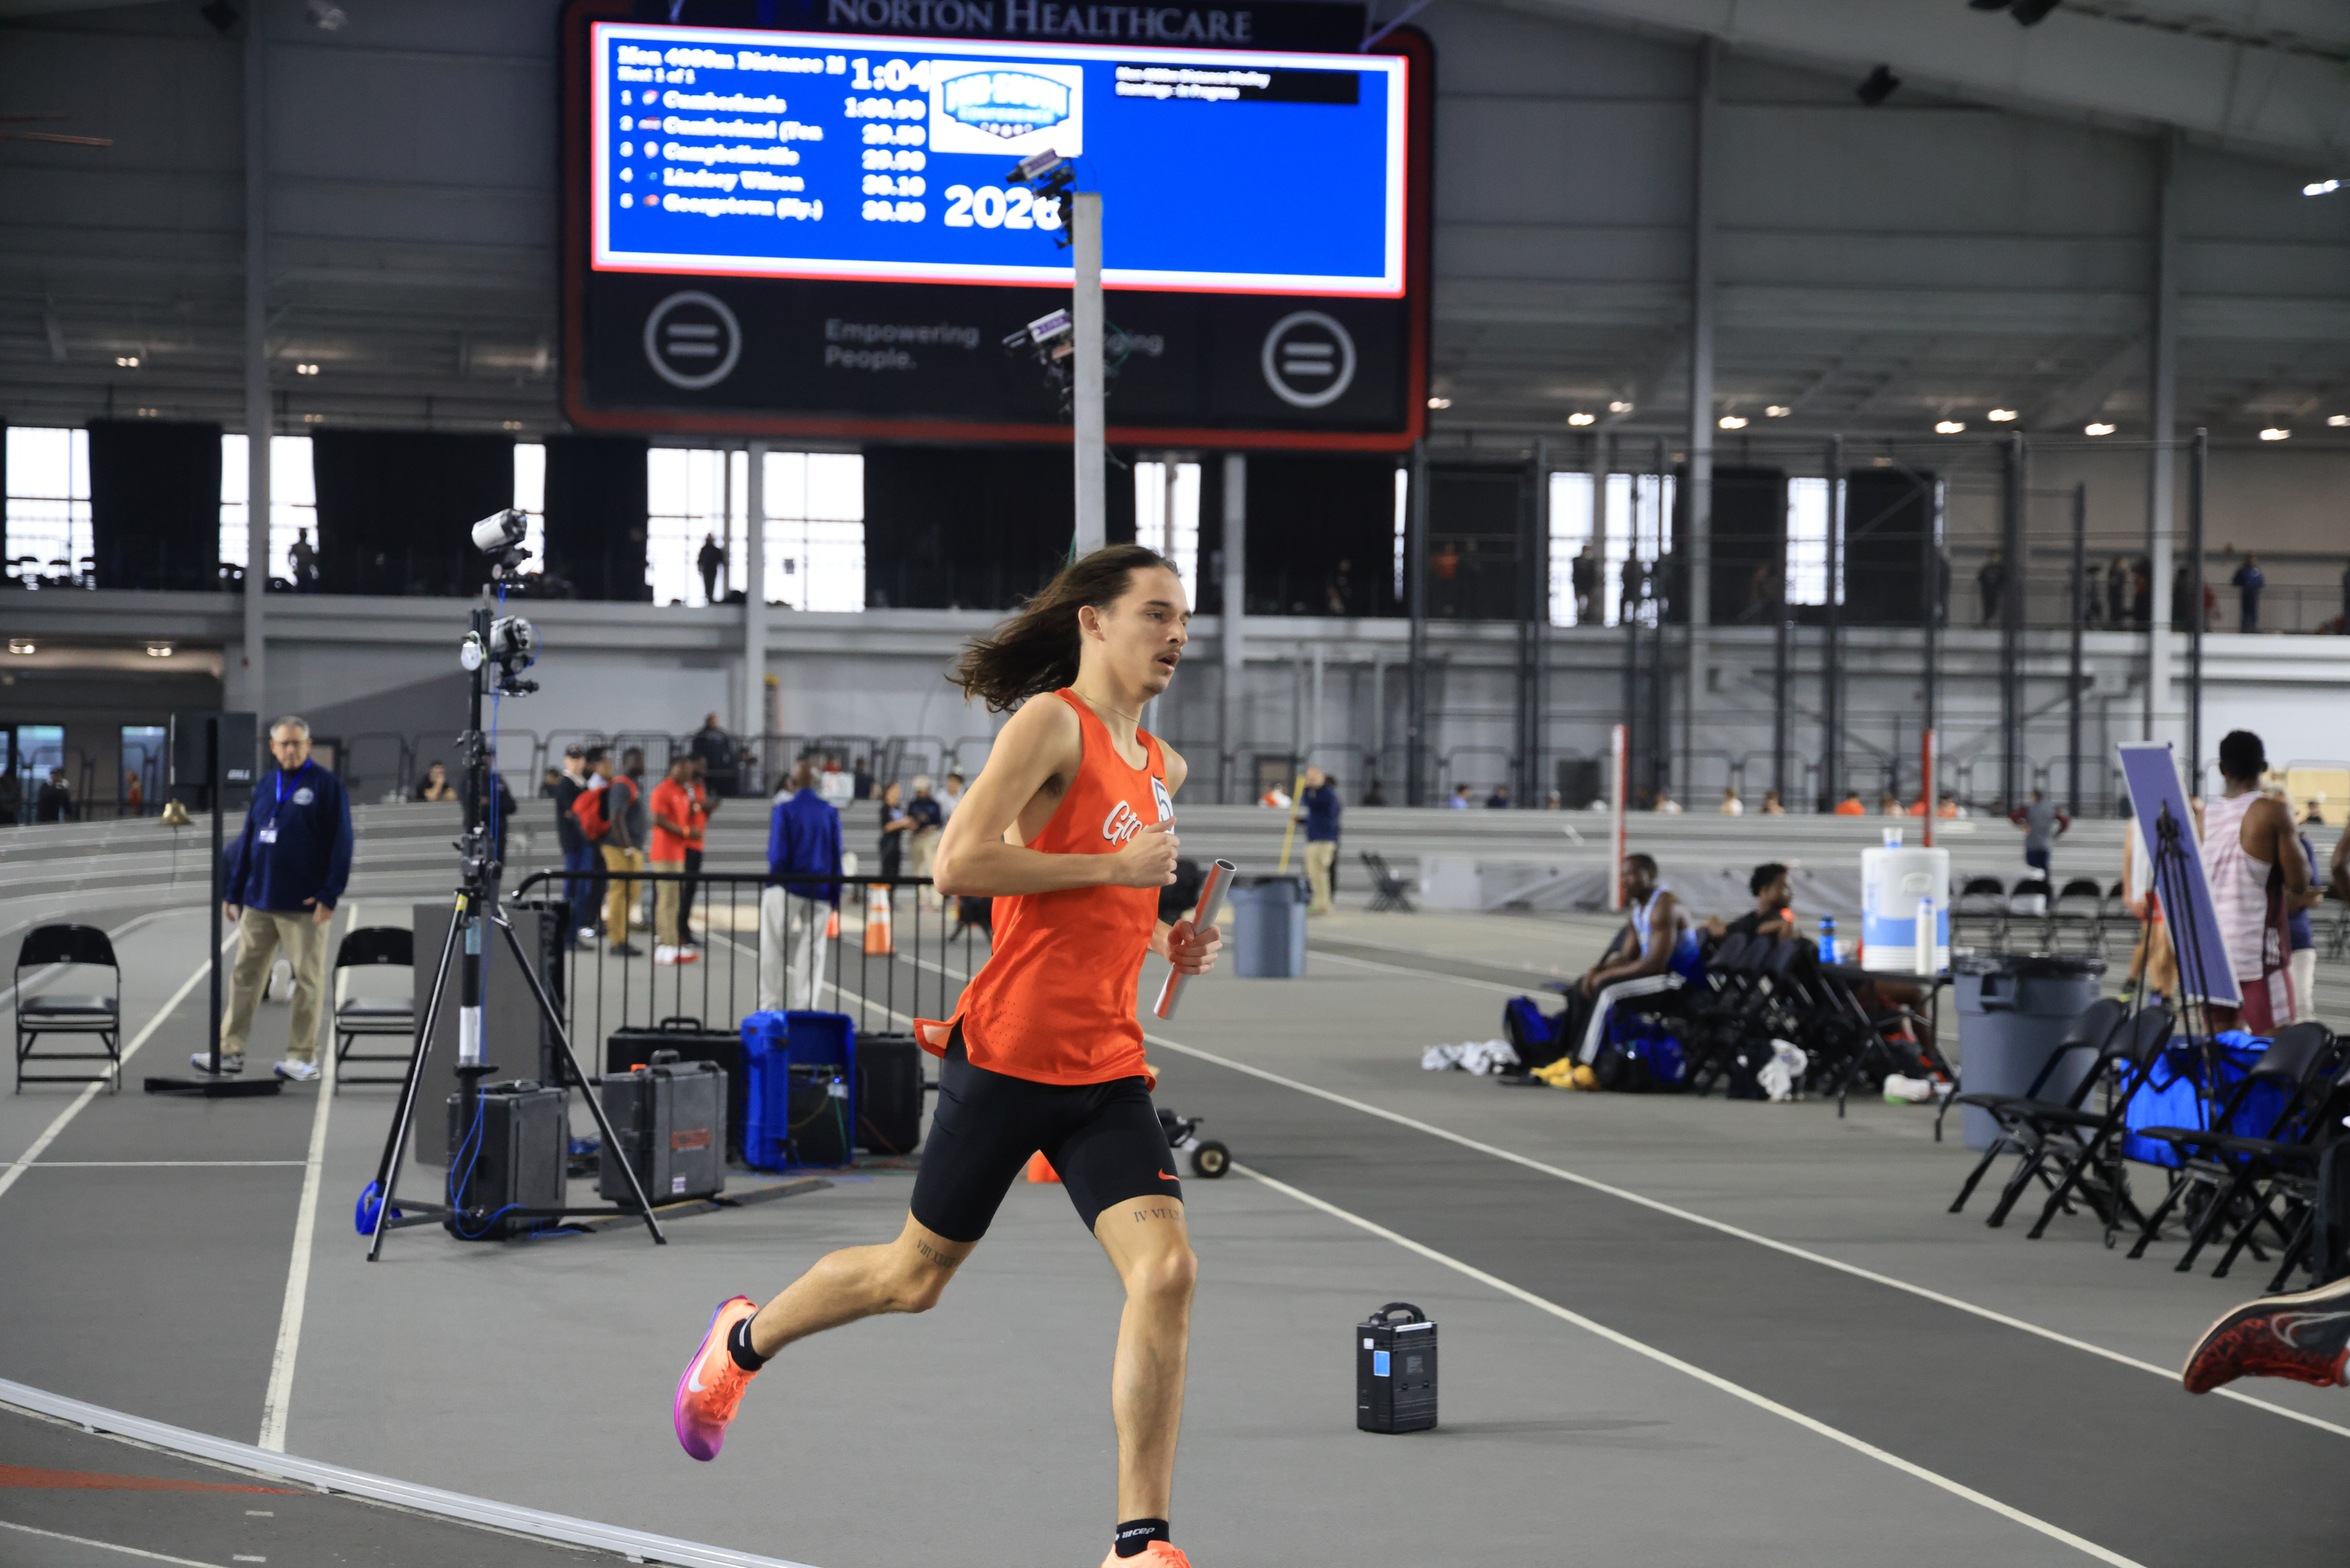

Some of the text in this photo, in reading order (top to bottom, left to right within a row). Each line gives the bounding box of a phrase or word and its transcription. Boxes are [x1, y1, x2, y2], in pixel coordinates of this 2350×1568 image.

[827, 0, 1253, 42] NORTON HEALTHCARE
[621, 90, 632, 105] 1
[620, 115, 633, 131] 2
[663, 116, 777, 139] Cumberland
[620, 141, 633, 157] 3
[619, 167, 633, 183] 4
[663, 167, 739, 192] Lindsey
[740, 170, 805, 192] Wilson
[620, 193, 633, 209] 5
[663, 193, 775, 218] Georgetown
[944, 184, 1062, 231] 2026
[826, 318, 980, 350] Empowering
[826, 346, 917, 373] People.
[1103, 800, 1149, 846] Gto
